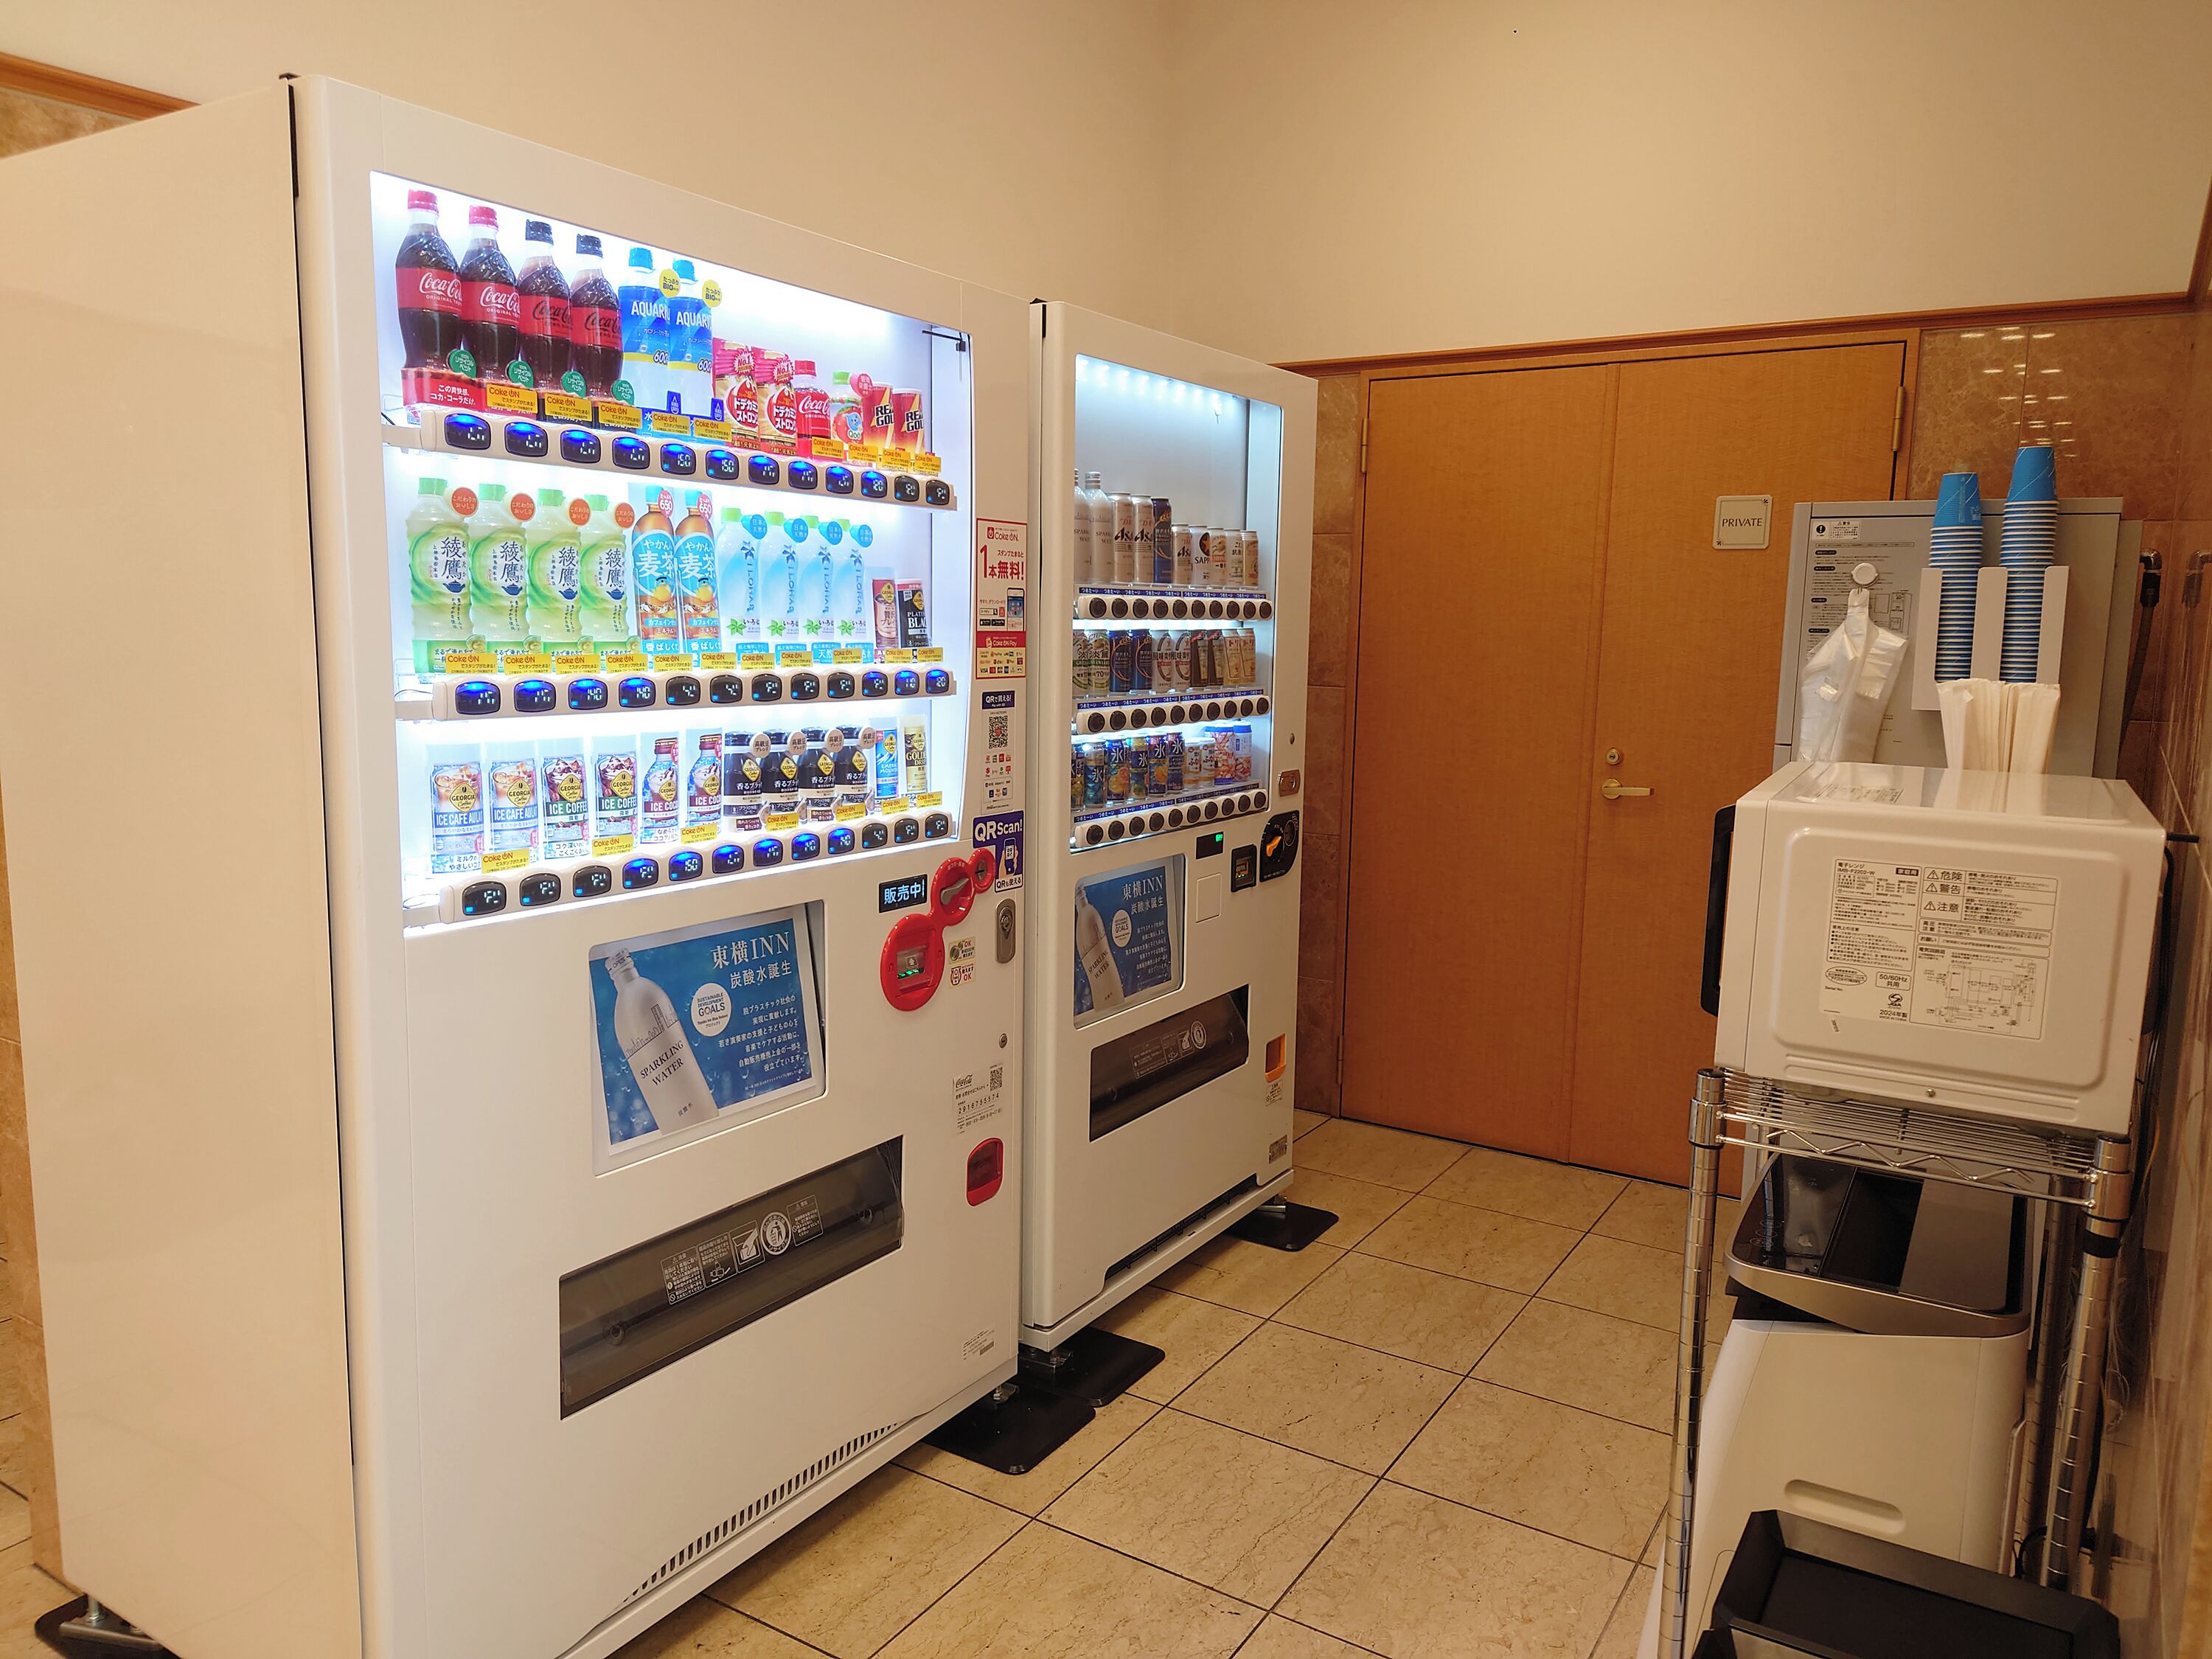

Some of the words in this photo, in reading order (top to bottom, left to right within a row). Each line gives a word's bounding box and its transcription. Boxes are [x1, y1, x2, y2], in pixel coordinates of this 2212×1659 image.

[663, 282, 673, 291] BIG
[426, 295, 452, 304] ORIGINAL
[705, 293, 715, 301] BIG
[487, 307, 511, 316] ORIGINAL
[455, 356, 474, 367] リサイクル
[737, 355, 751, 366] No.1
[459, 363, 472, 372] ペット
[513, 368, 532, 378] リサイクル
[776, 364, 790, 375] No.1
[518, 375, 529, 383] ペット
[489, 387, 508, 397] Coke
[546, 397, 564, 405] Coke
[734, 398, 758, 411] ドデカミ
[600, 405, 616, 413] Coke
[773, 406, 796, 420] ドデカミ
[876, 415, 894, 428] GOL
[906, 420, 924, 432] GOL
[848, 430, 861, 439] Qoo
[659, 499, 672, 510] 650
[699, 503, 712, 514] 650
[1722, 518, 1763, 527] PRIVATE
[643, 539, 670, 551] やかん
[685, 542, 711, 552] やかん
[441, 536, 462, 580] 綾鷹
[500, 540, 520, 583] 綾鷹
[558, 546, 577, 587] 綾鷹
[1228, 639, 1239, 647] トリ
[467, 654, 480, 662] ON
[737, 780, 762, 790] 香るブラッ
[774, 779, 799, 788] 香るブラッ
[549, 804, 564, 815] ICE
[602, 799, 616, 810] ICE
[650, 802, 664, 812] ICE
[448, 813, 468, 825] CAFE
[506, 808, 524, 820] CAFE
[975, 821, 998, 842] QR
[998, 818, 1023, 835] Scan!
[1940, 871, 1963, 882] 危険
[883, 881, 922, 905] 販売中
[1122, 875, 1164, 901] 東横INN
[1939, 883, 1961, 894] 警告
[1130, 896, 1164, 915] 炭酸水誕生
[1937, 901, 1959, 913] 注意
[1115, 923, 1129, 933] GOALS
[711, 931, 790, 970] 東横INN
[730, 959, 792, 990] 炭酸水誕生
[963, 973, 972, 981] OK
[1879, 973, 1907, 983] 50/60Hz
[698, 998, 724, 1008] DEVELOPMENT
[698, 1003, 726, 1017] GOALS
[1879, 1009, 1907, 1018] 2024年製
[640, 1040, 684, 1079] SPARKLING
[652, 1057, 684, 1087] WATER
[956, 1074, 973, 1088] Coca-Cola
